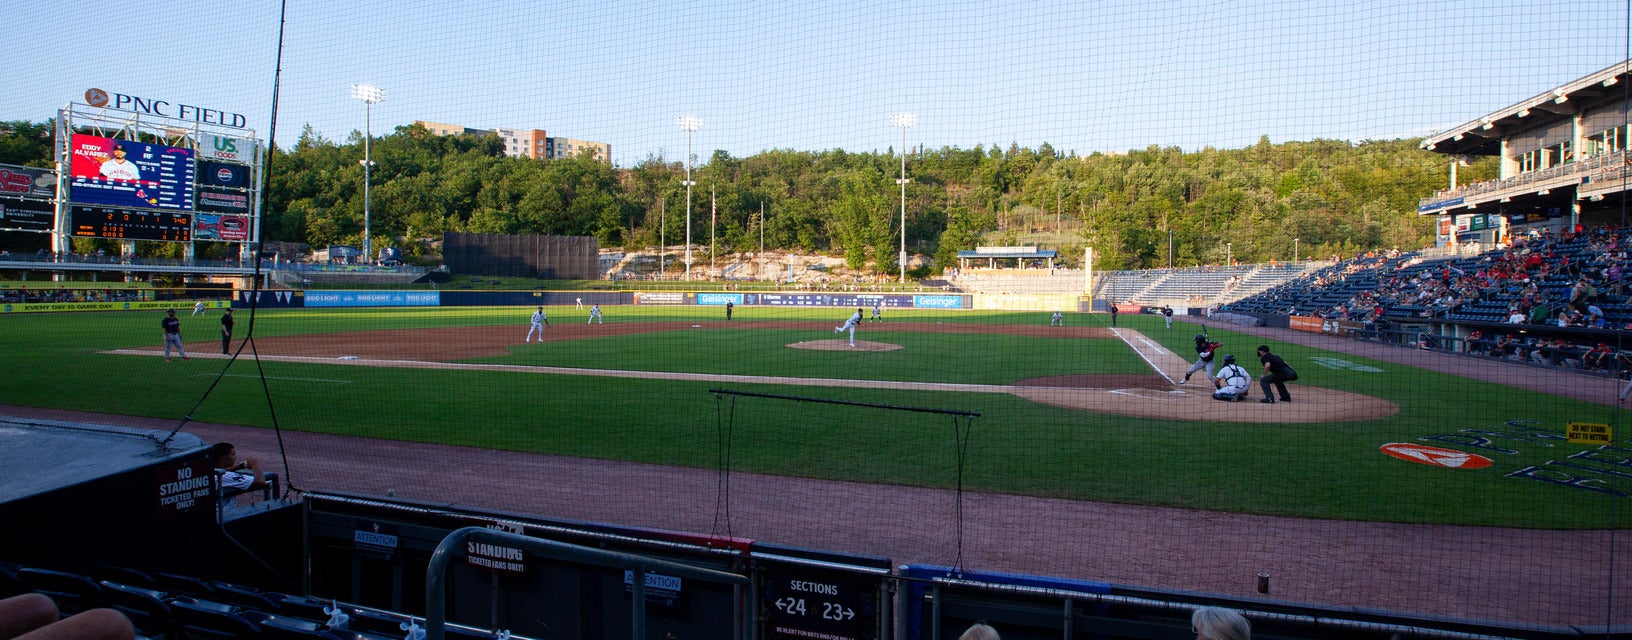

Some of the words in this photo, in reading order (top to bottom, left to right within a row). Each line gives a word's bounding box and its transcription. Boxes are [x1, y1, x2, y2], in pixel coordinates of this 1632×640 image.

[113, 92, 170, 116] PNC
[178, 104, 247, 128] FIELD
[74, 149, 108, 158] ALVAREZ
[82, 144, 101, 152] EDDY
[214, 151, 236, 159] FOODS
[702, 294, 737, 304] Geisinger
[920, 296, 957, 307] Geisinger
[178, 466, 193, 480] NO
[159, 475, 210, 496] STANDING
[160, 492, 192, 506] TICKETED
[193, 488, 210, 498] FANS
[176, 498, 195, 510] ONLY!
[356, 532, 396, 546] ATTENTION
[467, 541, 523, 561] STANDING
[468, 555, 492, 568] TICKETED
[492, 560, 507, 570] FANS
[507, 562, 524, 573] ONLY!
[627, 572, 679, 589] AENTION
[790, 580, 838, 595] SECTIONS
[786, 597, 806, 616] 24
[823, 602, 843, 620] 23
